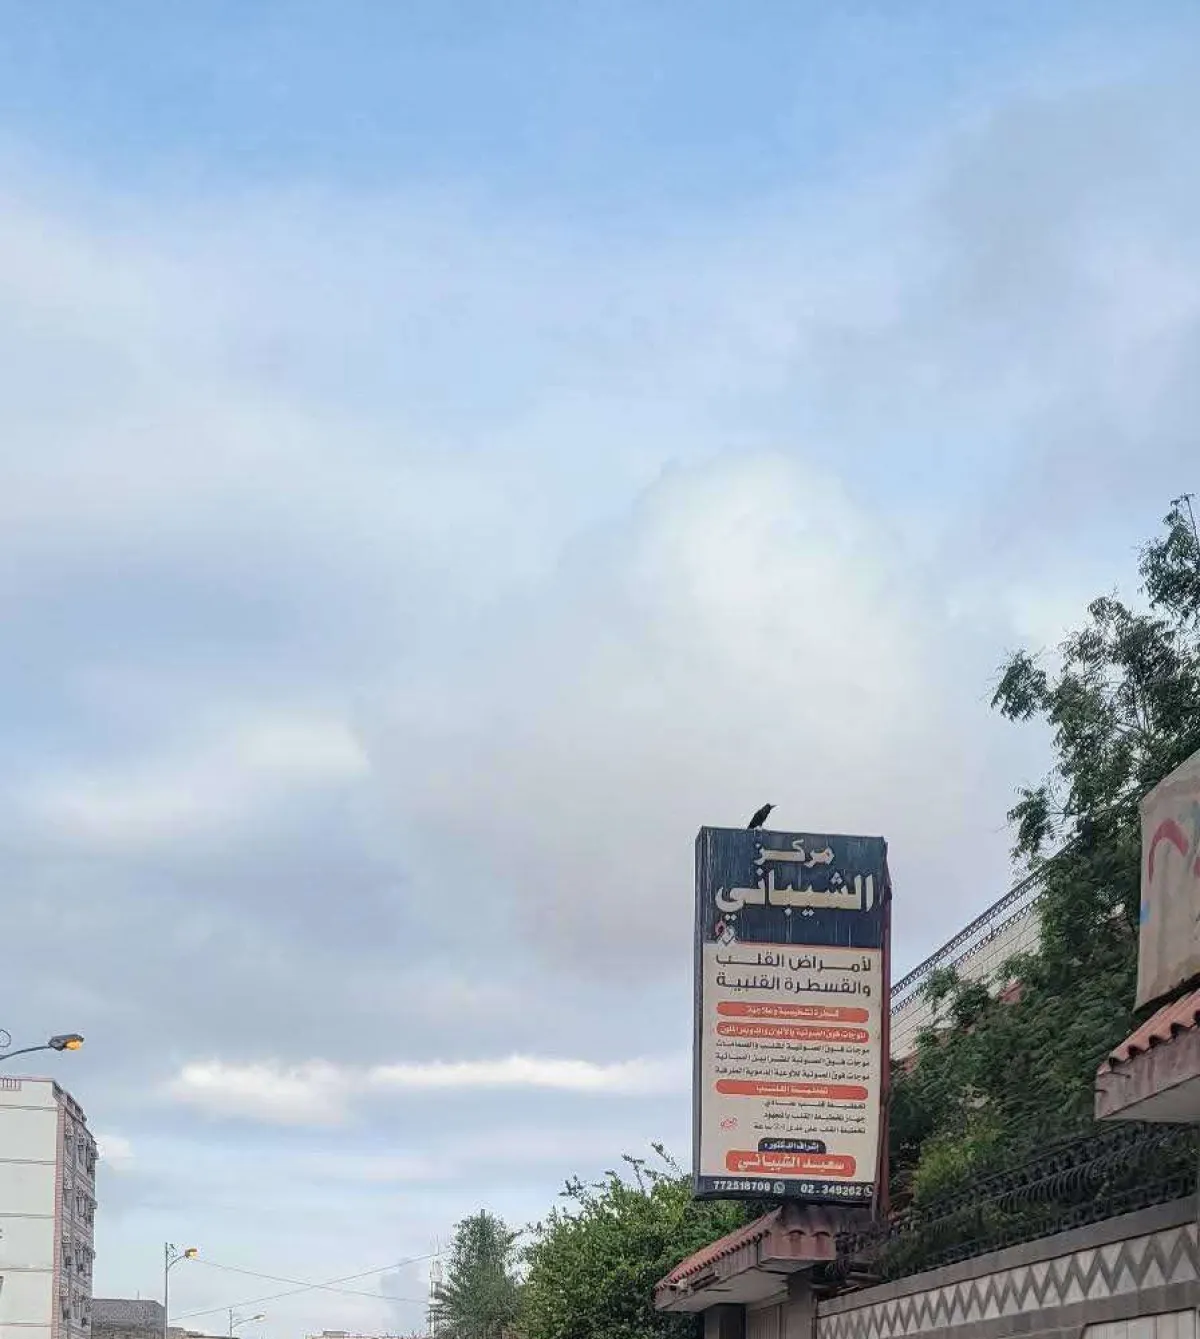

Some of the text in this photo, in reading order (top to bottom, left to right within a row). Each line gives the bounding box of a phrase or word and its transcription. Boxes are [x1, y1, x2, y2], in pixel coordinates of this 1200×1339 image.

[754, 839, 835, 868] مركز
[715, 868, 874, 921] الشيباني
[716, 951, 871, 972] لأمراض القلب
[716, 971, 871, 996] والقسطرة القلبية
